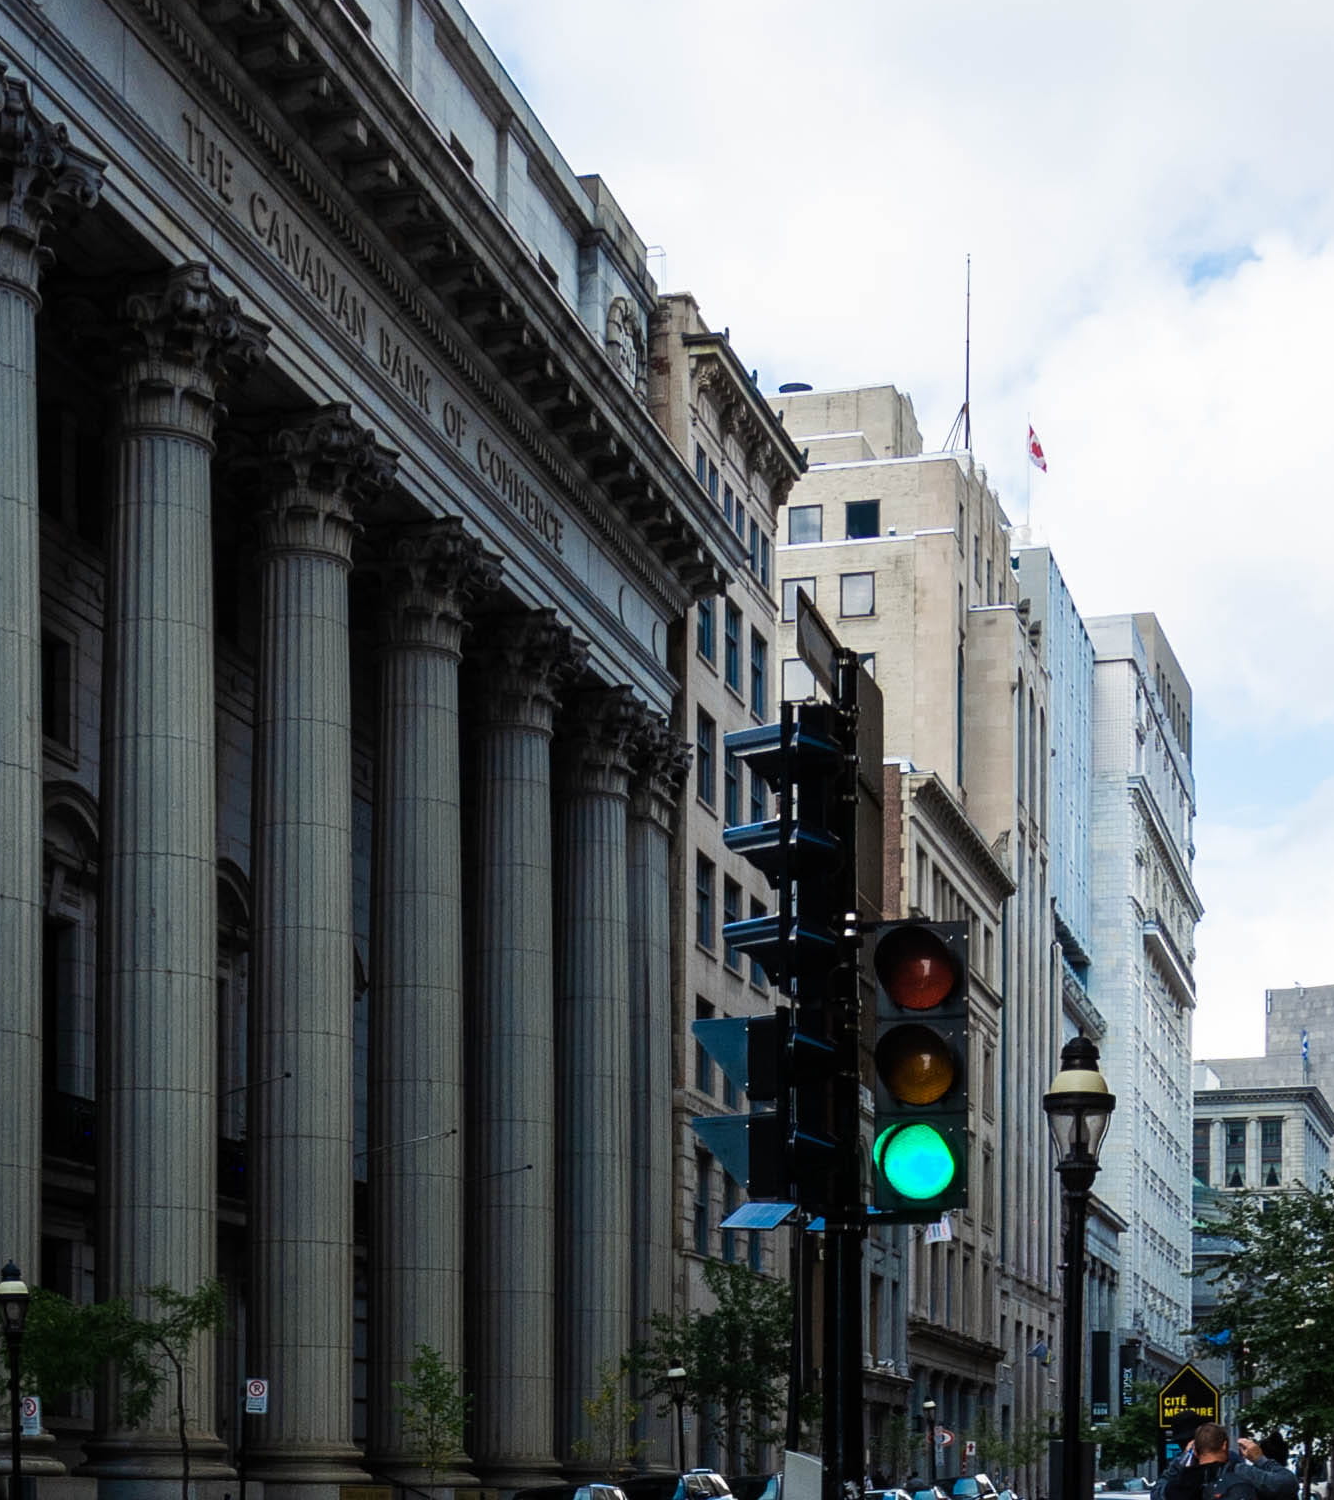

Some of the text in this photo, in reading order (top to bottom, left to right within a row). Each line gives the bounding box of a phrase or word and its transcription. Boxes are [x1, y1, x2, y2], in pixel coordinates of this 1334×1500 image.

[182, 113, 563, 557] THE CANADIAN BANK OF COMMERCE
[1163, 1393, 1188, 1408] CITÉ
[1163, 1406, 1214, 1419] MÉIRE
